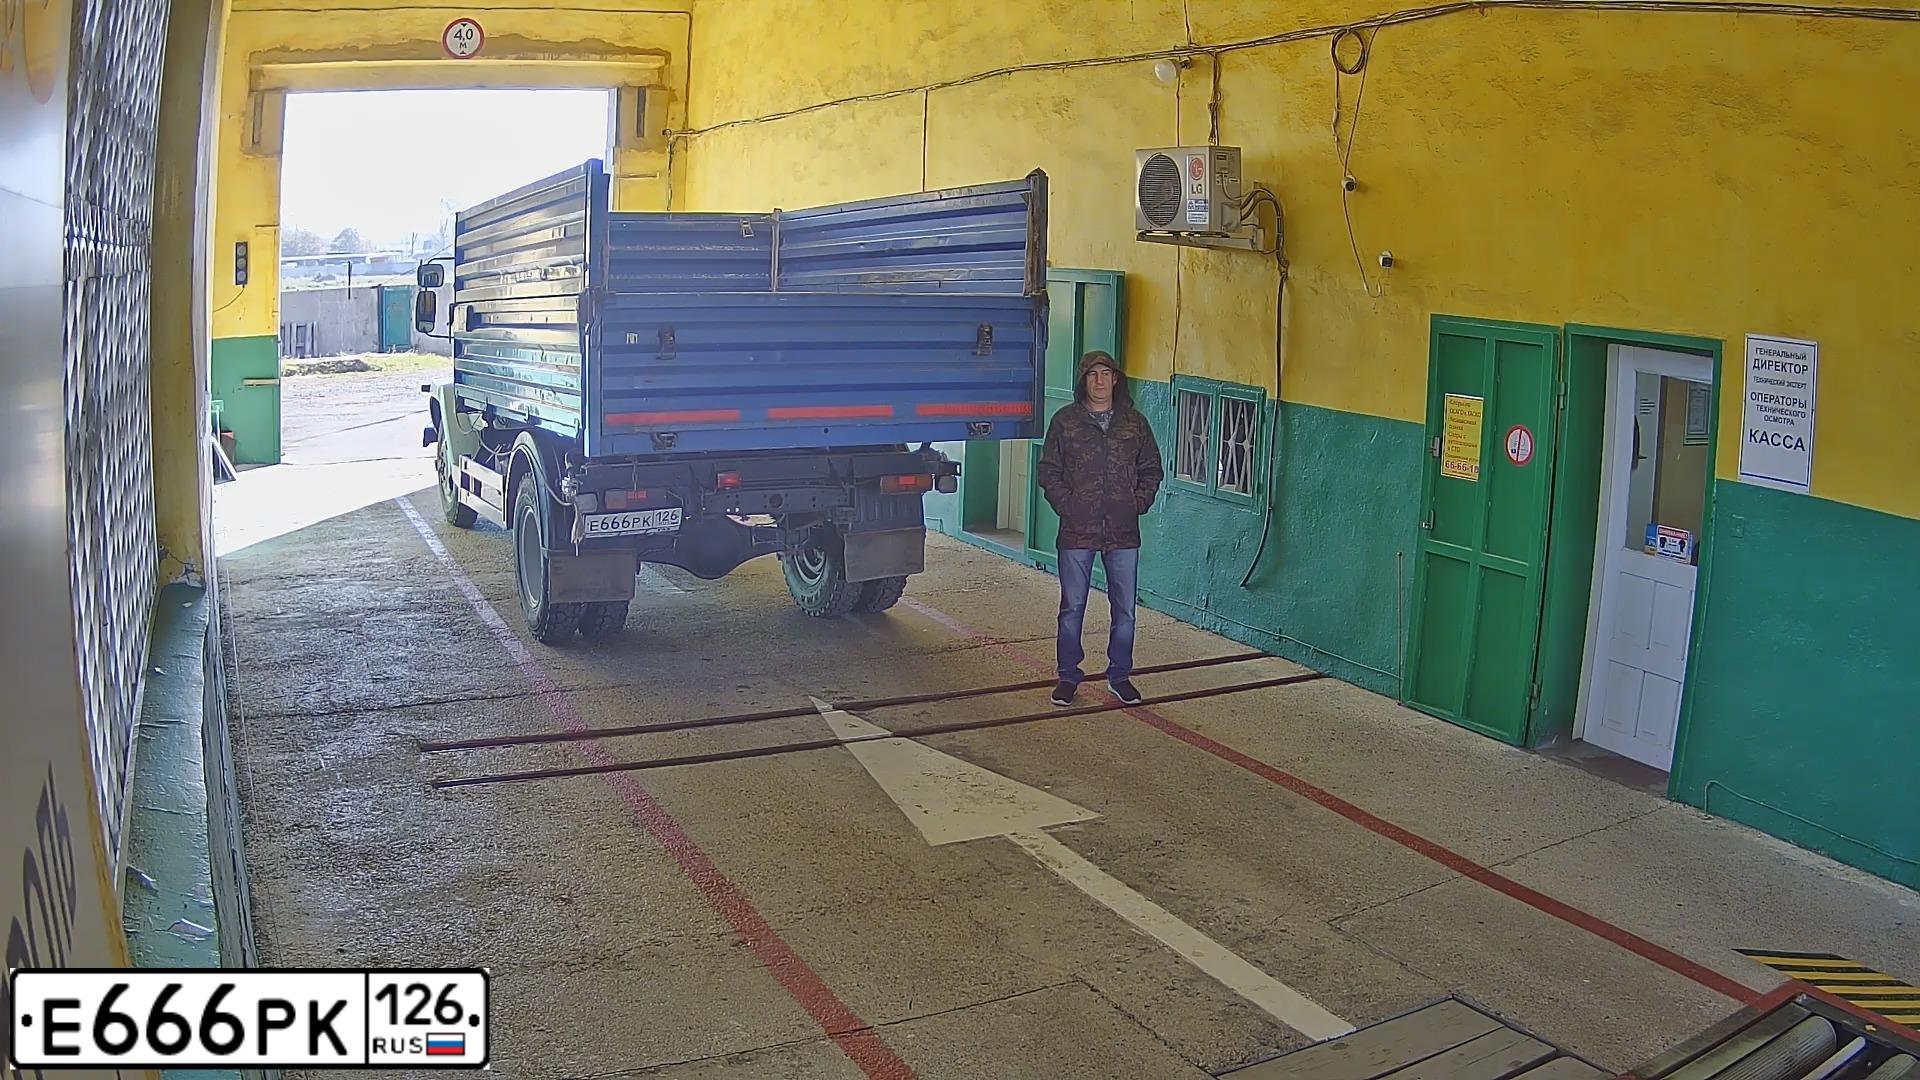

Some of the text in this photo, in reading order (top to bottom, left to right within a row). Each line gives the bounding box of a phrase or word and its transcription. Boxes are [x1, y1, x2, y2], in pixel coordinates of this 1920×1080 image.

[454, 28, 474, 41] 4,0
[1191, 183, 1203, 194] LG
[1755, 347, 1807, 360] ГЕНЕРАЛЬНЫЙ
[1752, 358, 1808, 375] ДИРЕКТОР
[1750, 391, 1807, 409] ОПЕРАТОРЫ
[1756, 404, 1806, 419] ТЕХНИЧЕСКОГО
[1763, 414, 1795, 426] ОСМОТРА
[1749, 428, 1806, 451] КАССА
[655, 510, 679, 522] 126
